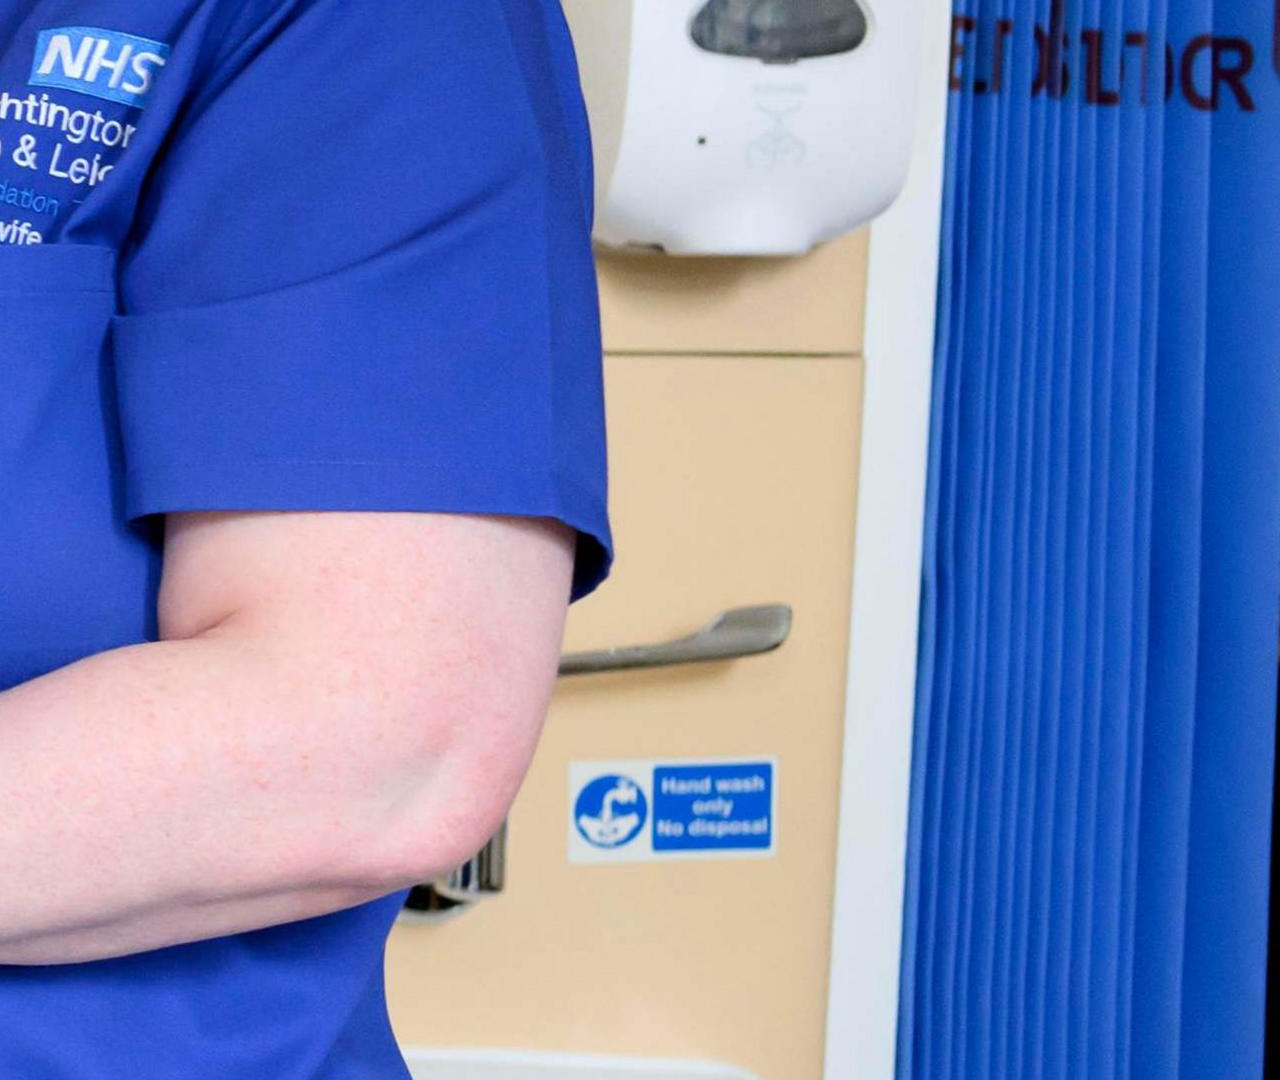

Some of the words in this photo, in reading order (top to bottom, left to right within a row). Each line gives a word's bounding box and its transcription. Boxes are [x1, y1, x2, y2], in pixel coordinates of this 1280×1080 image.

[36, 34, 166, 95] NHS
[12, 133, 38, 170] &
[661, 776, 711, 795] Hand
[715, 775, 765, 794] wash
[692, 797, 733, 818] only
[657, 819, 684, 837] No
[687, 817, 768, 838] disposal
